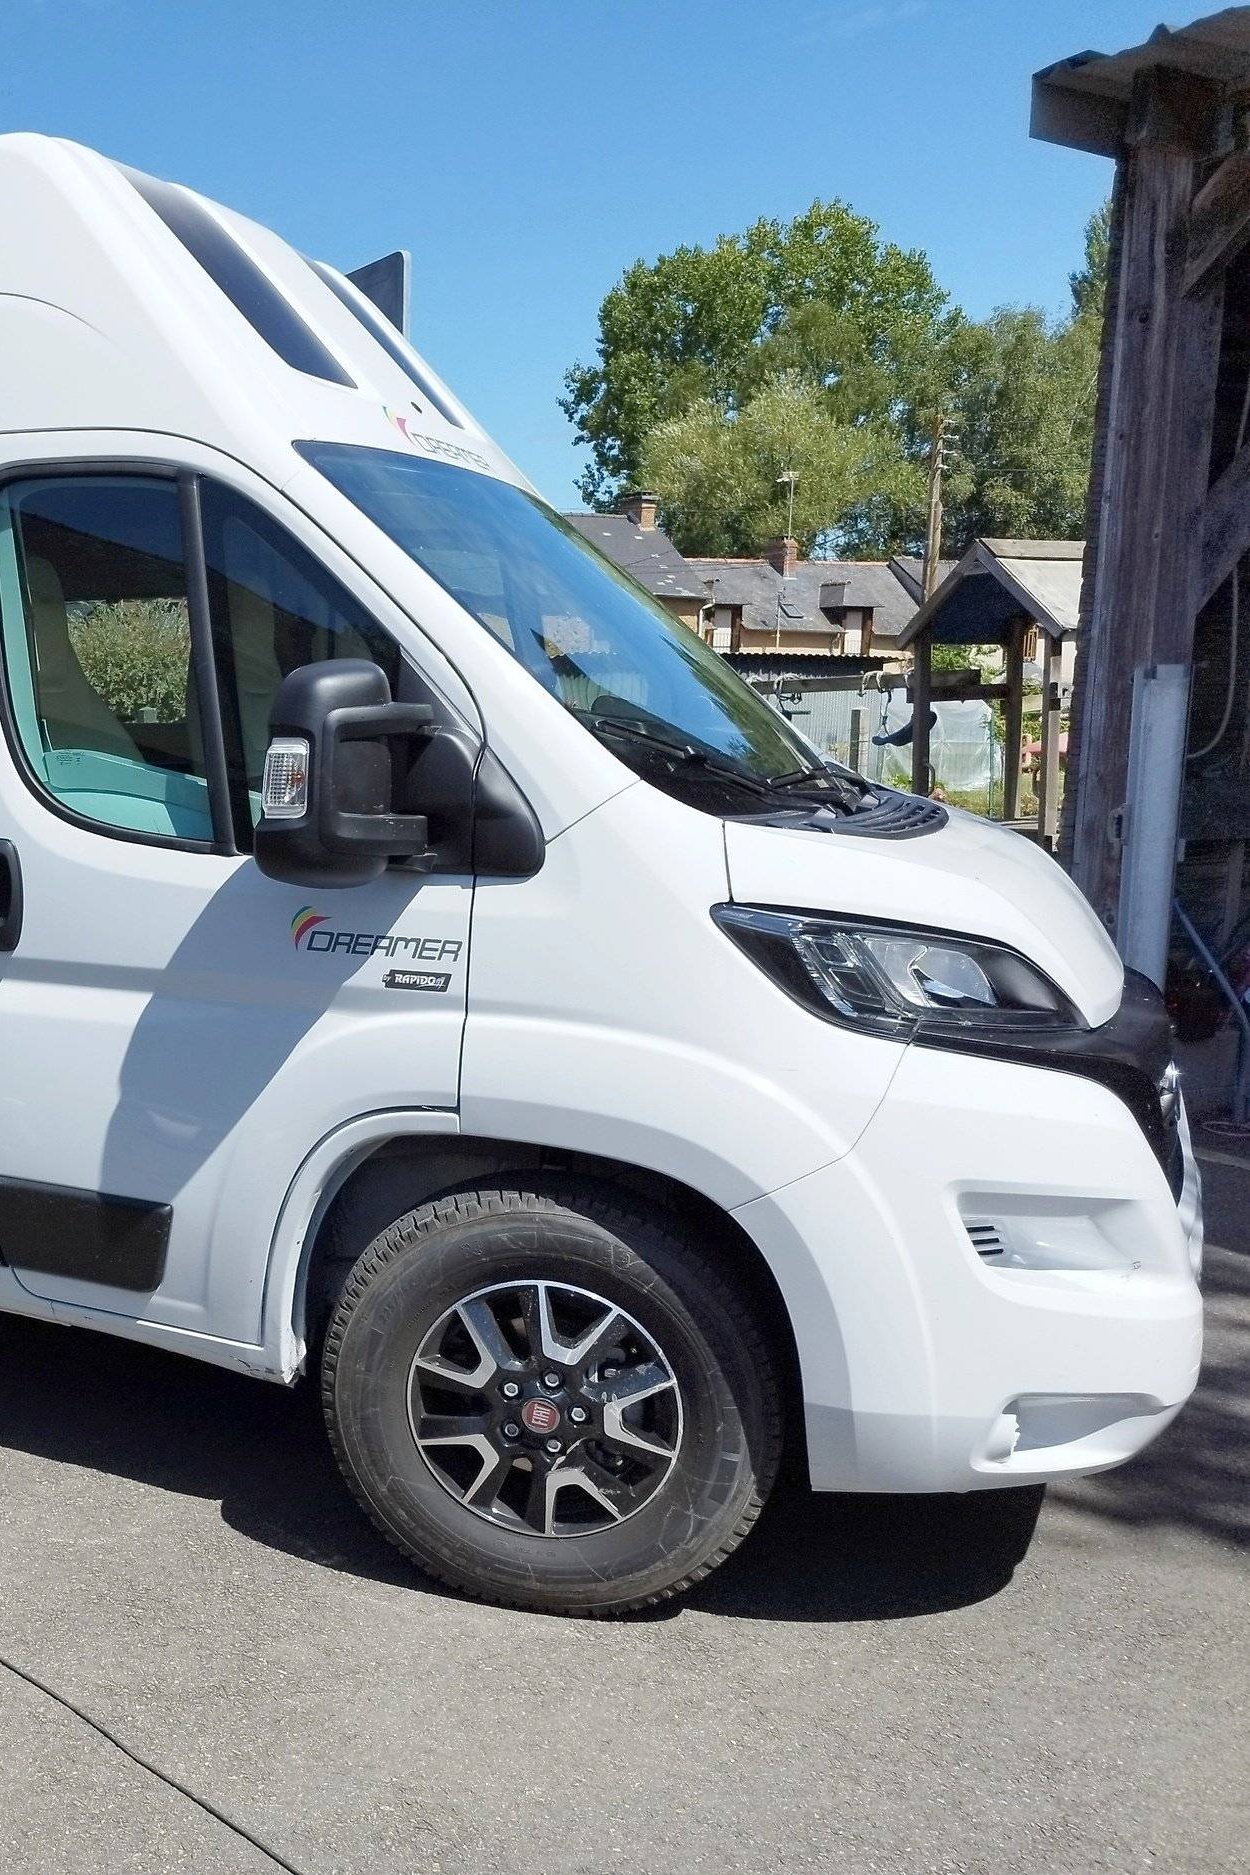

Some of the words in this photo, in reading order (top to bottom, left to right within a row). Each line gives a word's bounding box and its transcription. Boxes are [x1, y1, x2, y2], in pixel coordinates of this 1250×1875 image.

[306, 930, 463, 962] DREAMER
[394, 973, 437, 987] RAPIDO
[531, 1403, 551, 1427] FIAT
